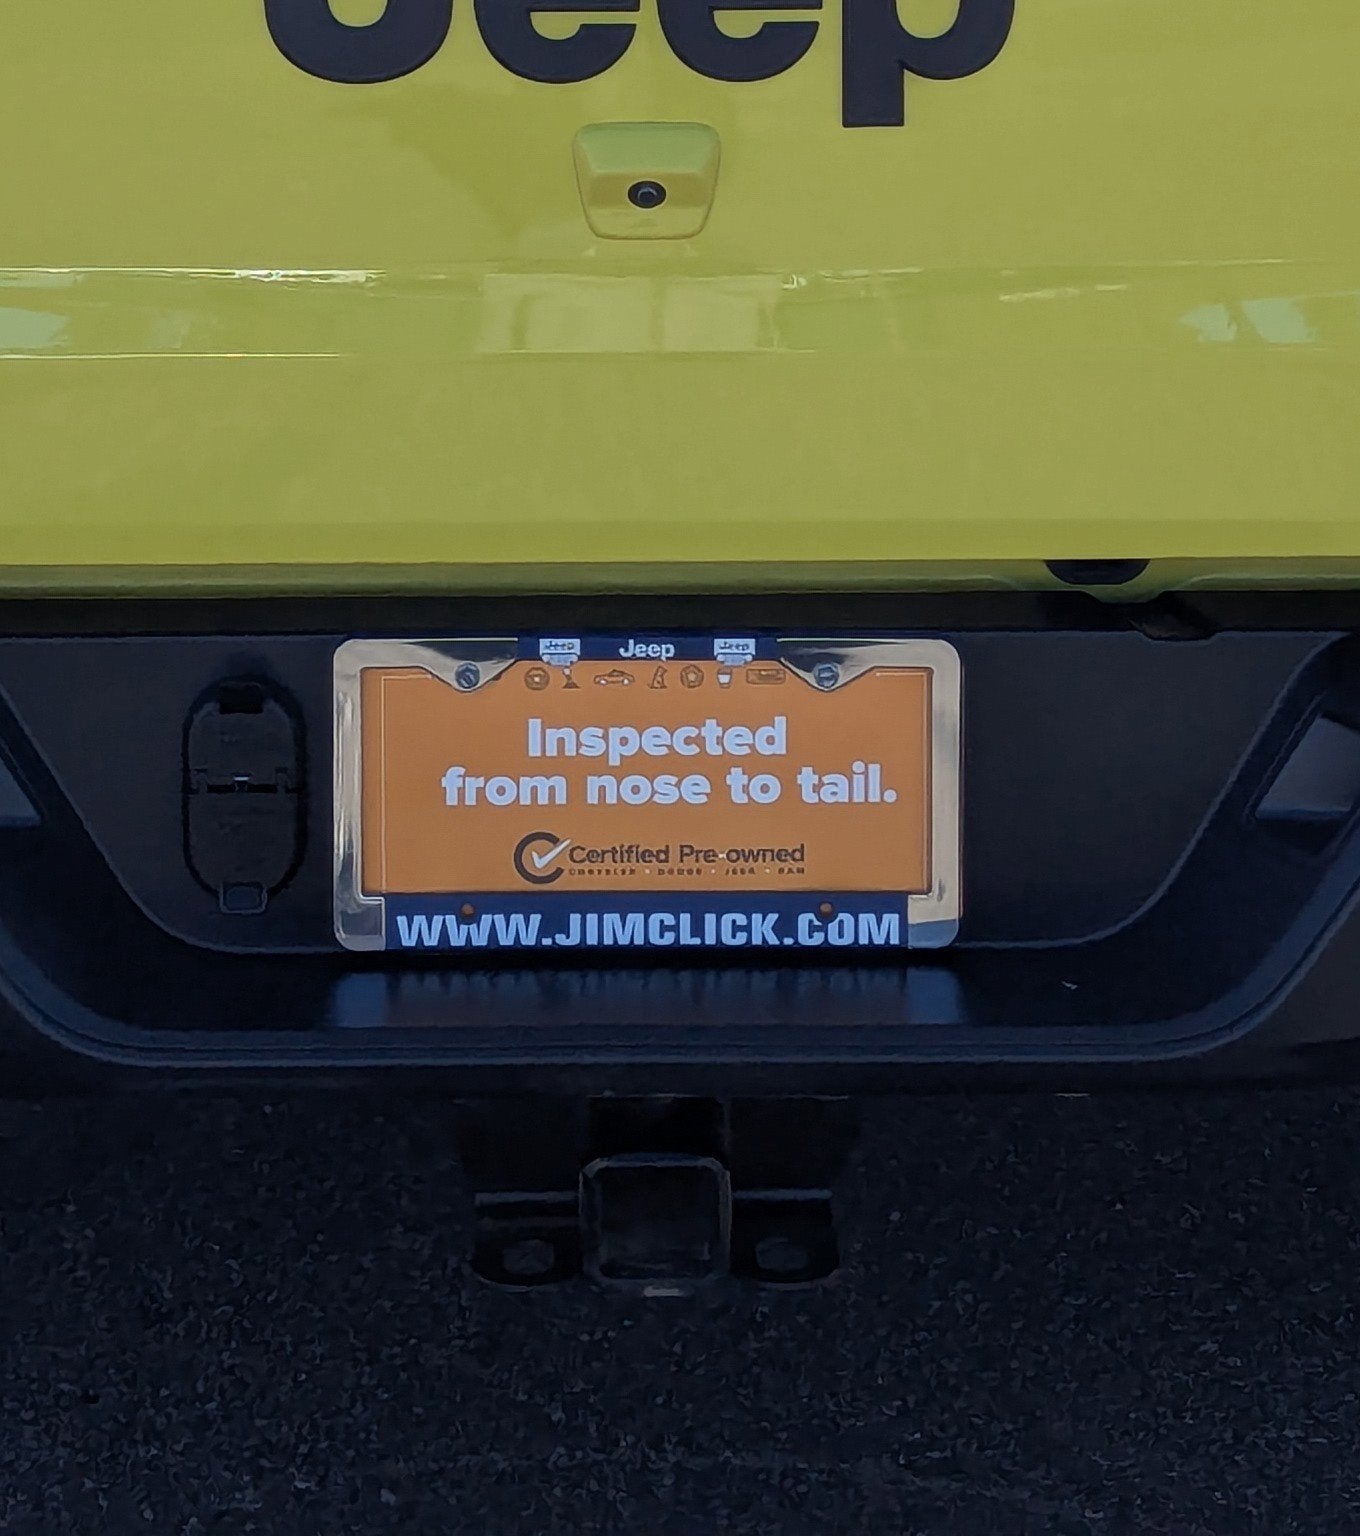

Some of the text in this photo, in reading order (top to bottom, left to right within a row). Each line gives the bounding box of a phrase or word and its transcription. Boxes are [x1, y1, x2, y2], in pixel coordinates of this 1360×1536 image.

[619, 639, 675, 661] Jeep
[528, 716, 786, 766] Inspected
[441, 761, 898, 806] from nose to tail.
[568, 843, 806, 864] Certified Pre-owned
[396, 912, 900, 947] WWW.JIMCLICK.COM
